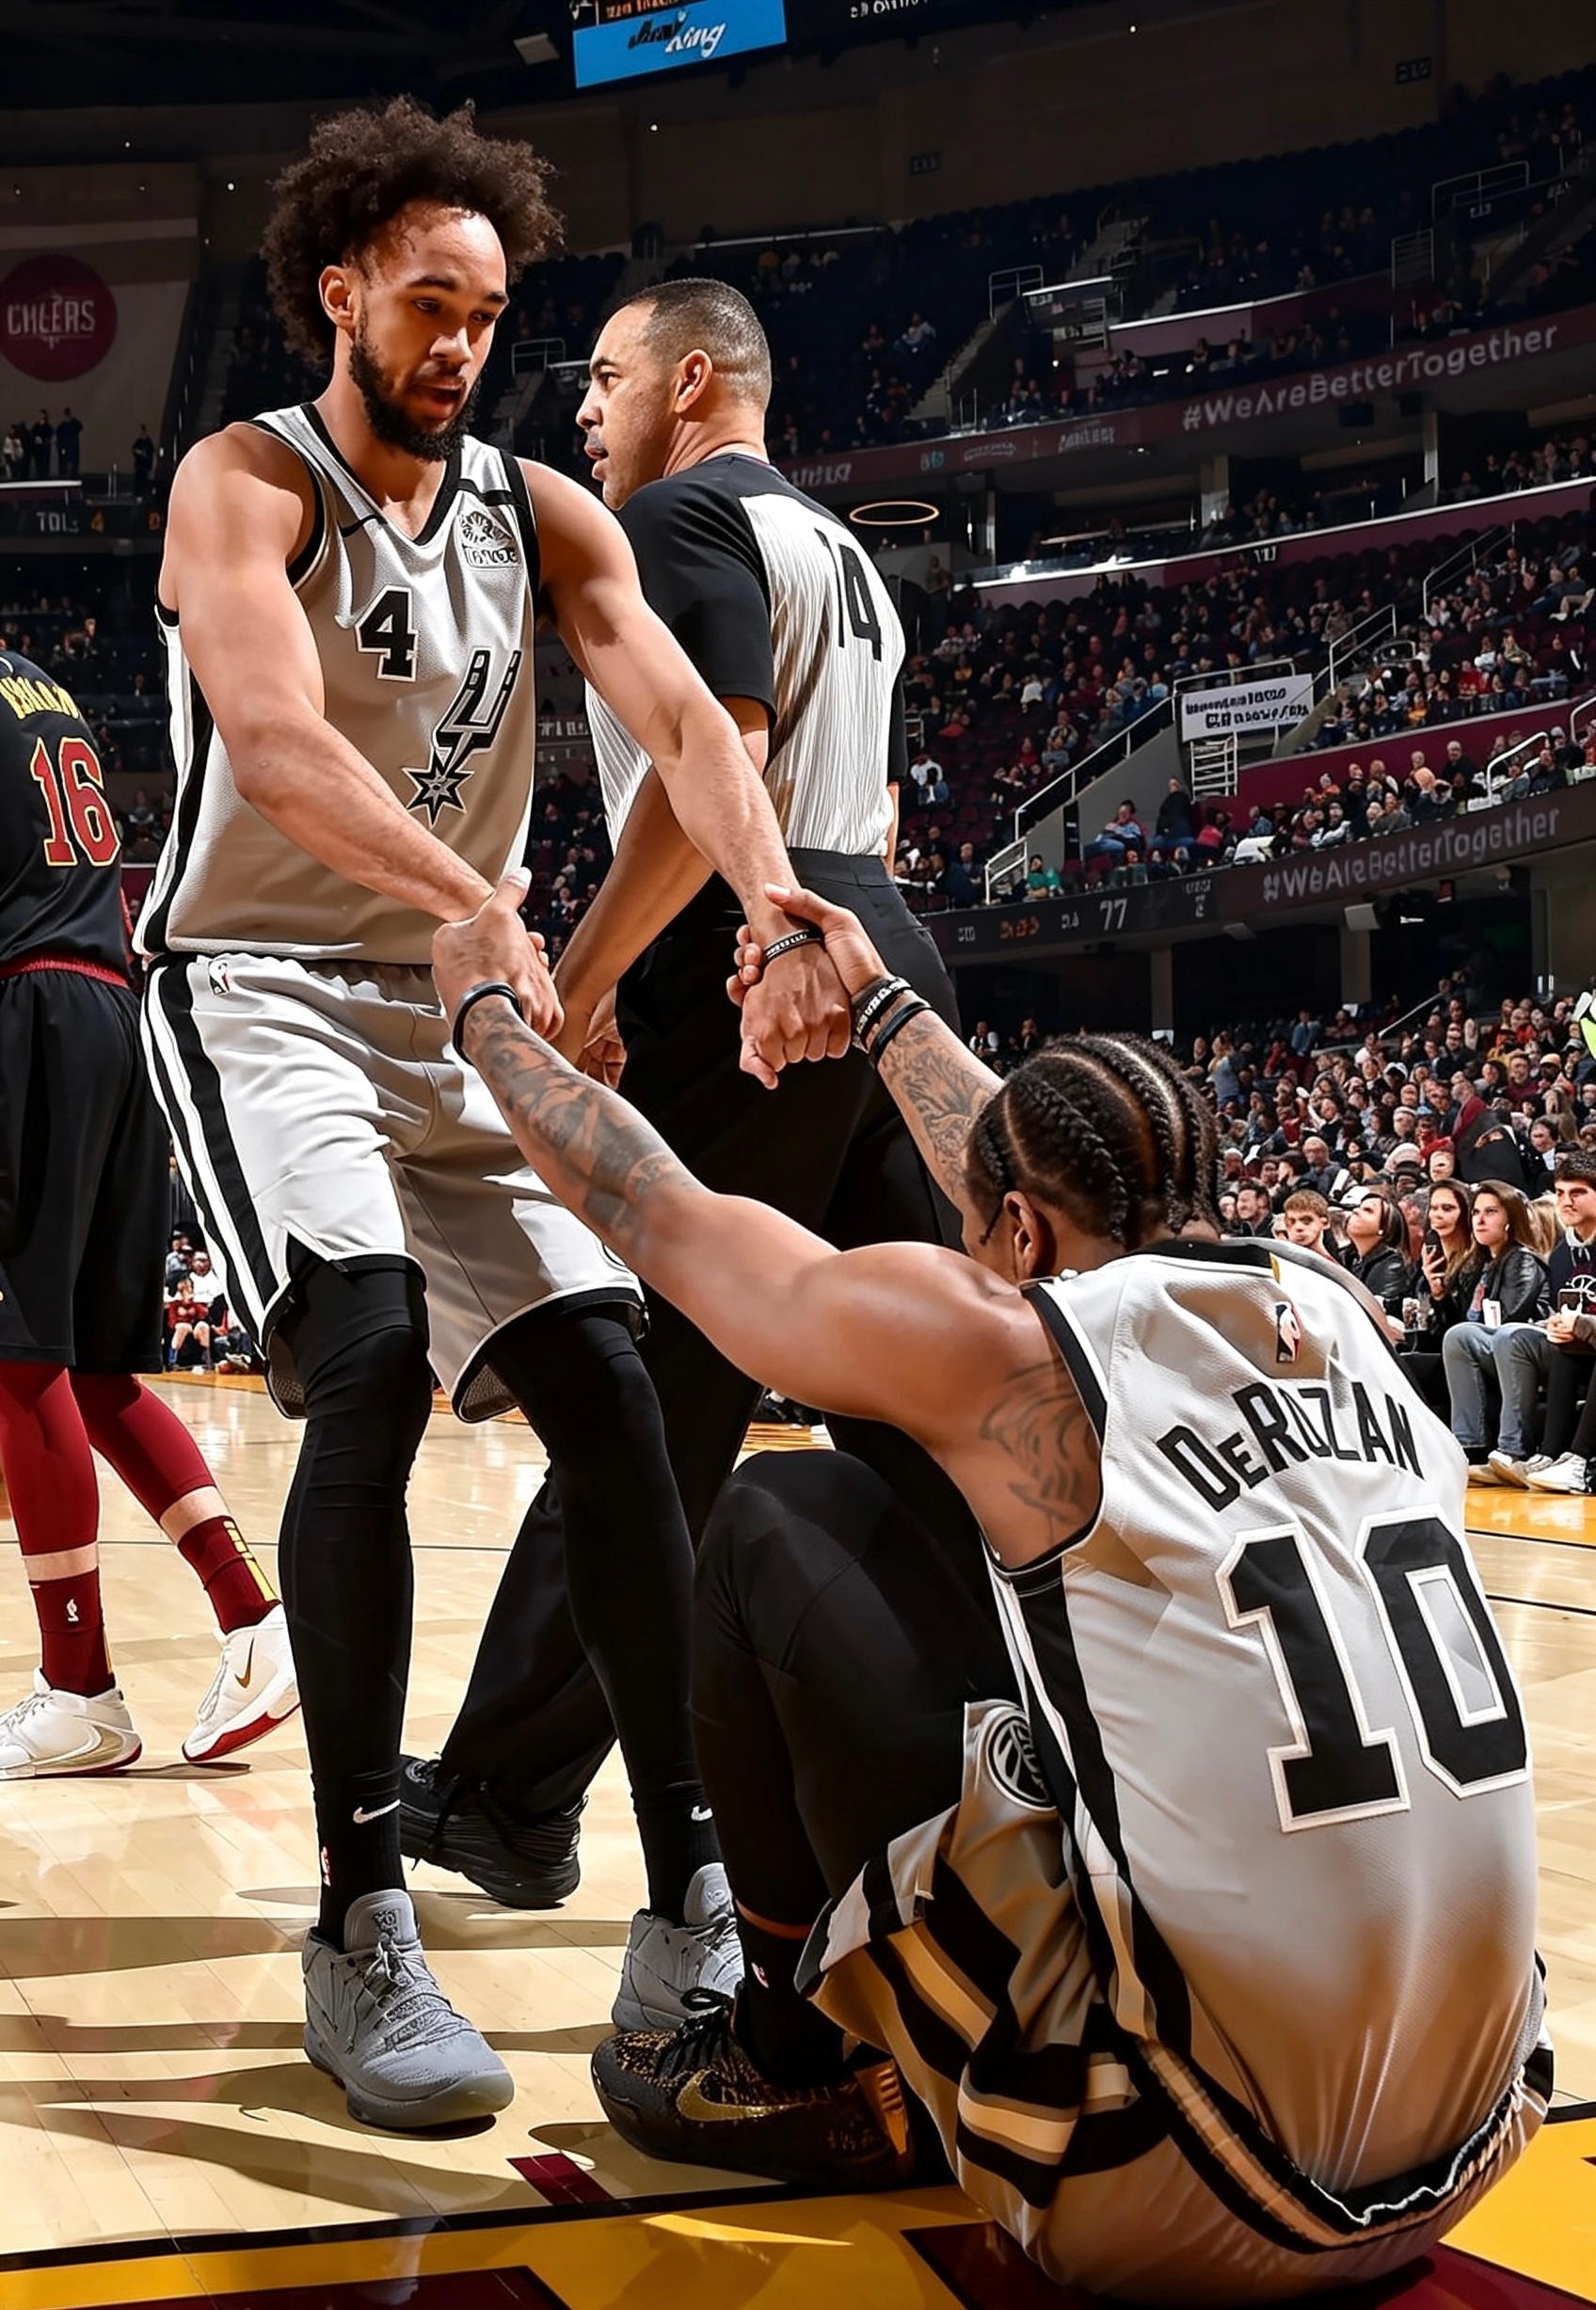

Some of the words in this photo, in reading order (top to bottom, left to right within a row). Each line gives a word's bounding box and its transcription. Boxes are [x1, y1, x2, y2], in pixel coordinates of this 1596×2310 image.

[1182, 326, 1558, 431] #WeAreBetterTogether
[355, 584, 418, 682] 4
[814, 527, 882, 662] 14
[30, 737, 120, 866] 16
[1263, 807, 1560, 902] #WeAreBetterTogether
[1099, 898, 1128, 931] 77
[1215, 1500, 1530, 1834] 10
